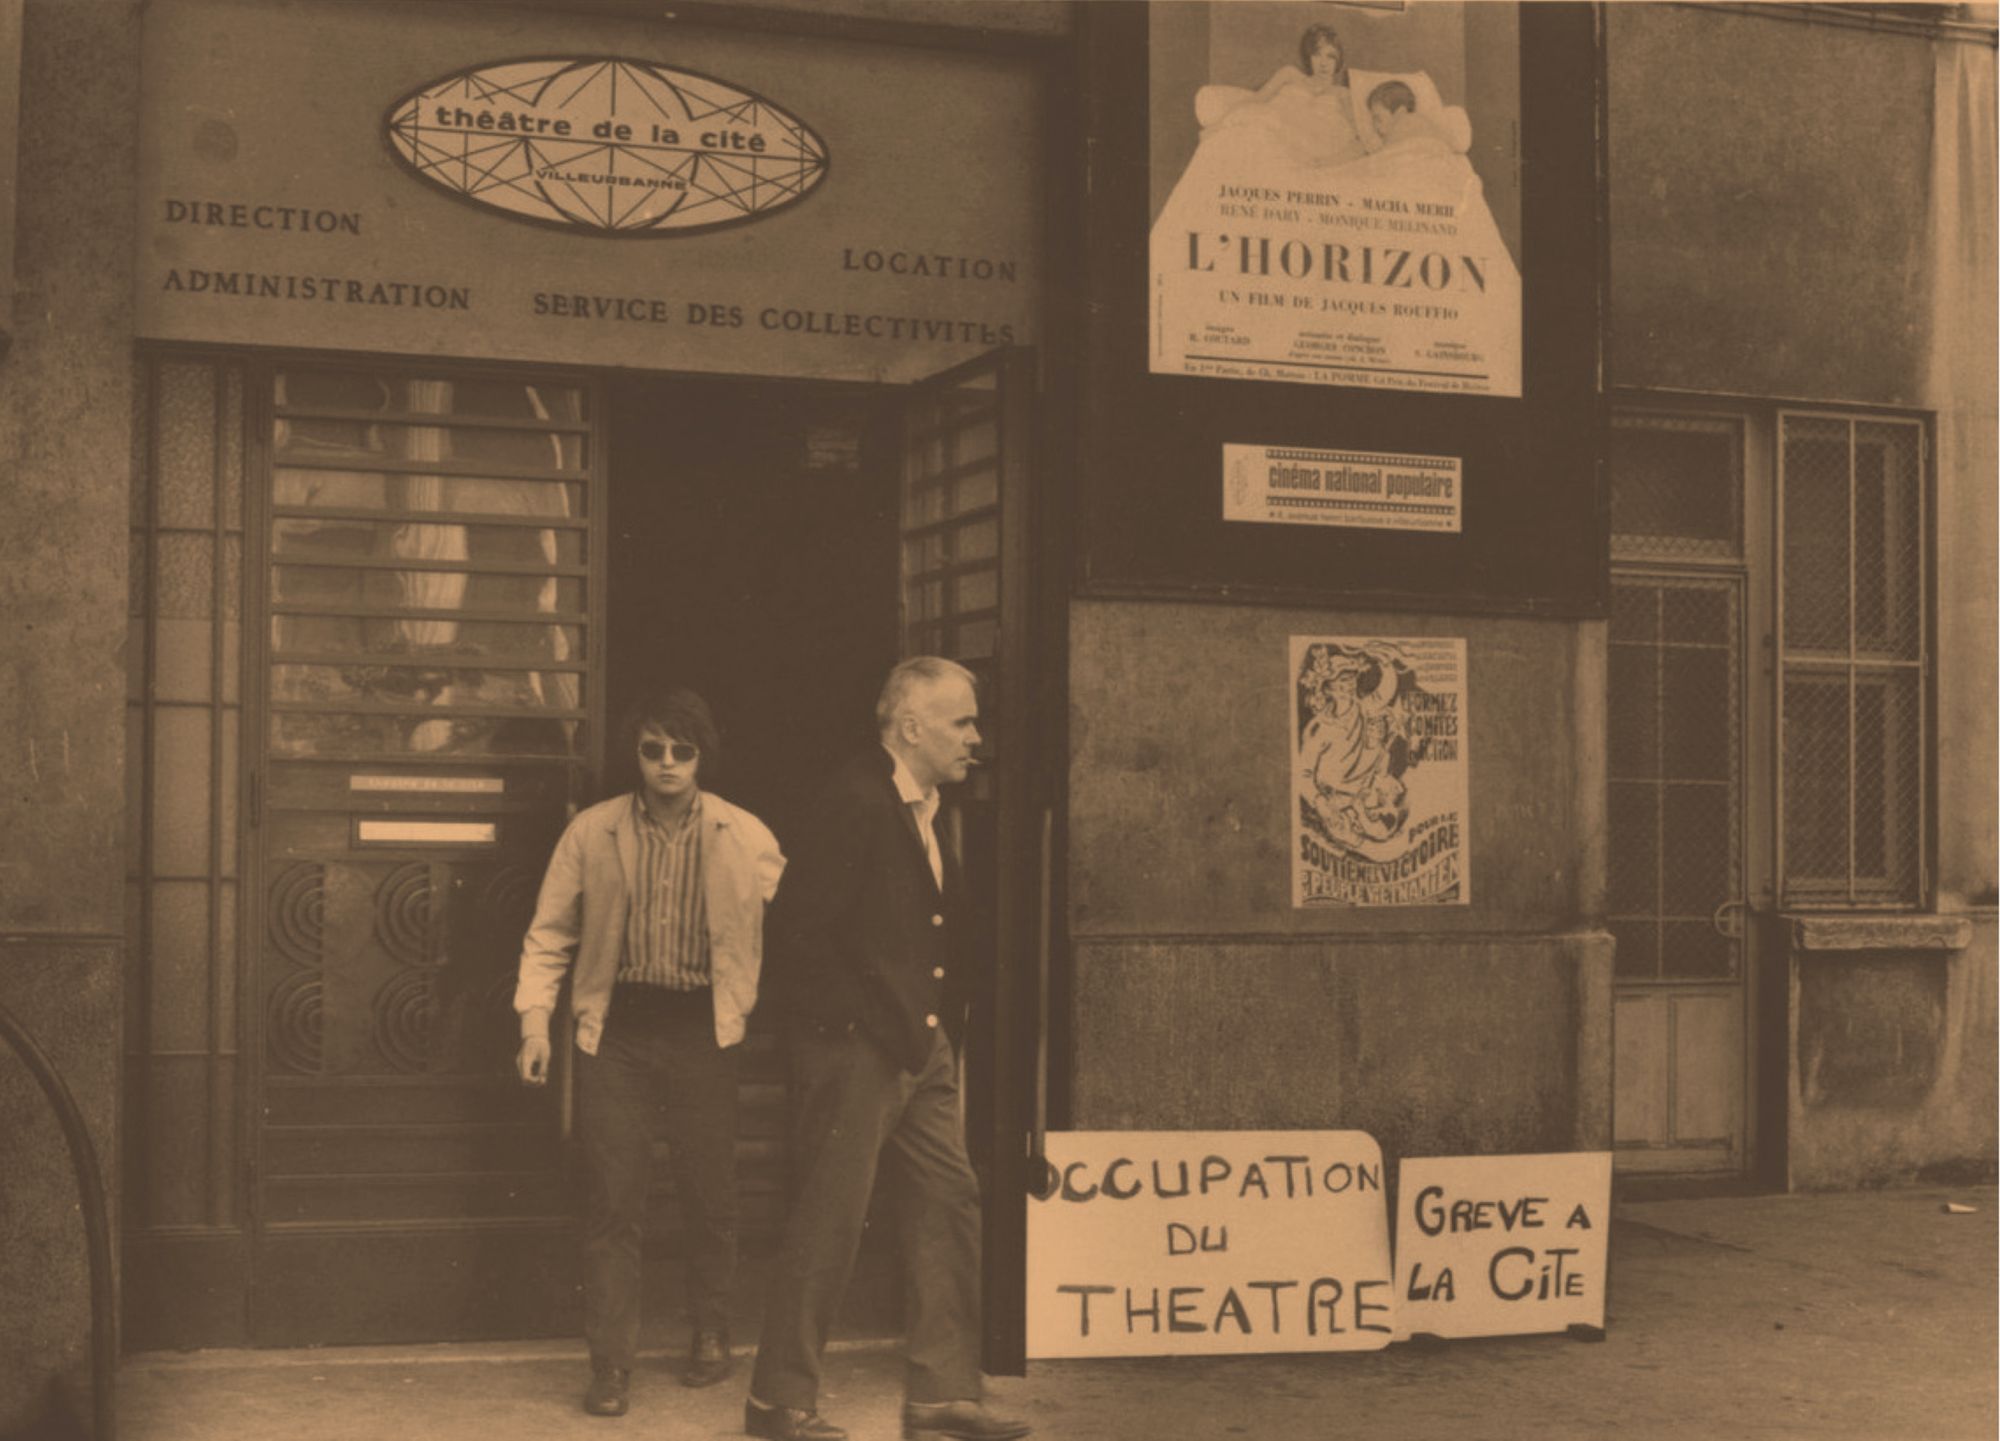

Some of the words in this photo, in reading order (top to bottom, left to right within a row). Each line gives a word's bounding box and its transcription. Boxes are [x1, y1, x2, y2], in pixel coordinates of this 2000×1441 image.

[436, 105, 571, 137] théâtre
[593, 113, 632, 141] de
[652, 123, 679, 146] la
[699, 128, 767, 153] cité
[535, 170, 687, 191] VILLEURBANNE
[1219, 184, 1281, 202] JACQUES
[1287, 190, 1339, 207] PERRIN
[1362, 197, 1408, 214] MACHA
[166, 200, 361, 235] DIRECTION
[843, 248, 1018, 284] LOCATION
[1187, 232, 1489, 294] L'HORIZON
[162, 268, 471, 310] ADMINISTRATION
[1219, 289, 1241, 304] UN
[1248, 292, 1281, 308] FILM
[1292, 295, 1313, 310] DE
[1321, 298, 1387, 316] JACQUES
[1392, 304, 1460, 321] ROUFFIO
[534, 292, 668, 323] SERVICE
[686, 302, 743, 330] DES
[1268, 461, 1320, 491] cinéma
[1325, 466, 1382, 495] national
[1386, 471, 1453, 501] populaire
[1414, 1185, 1550, 1237] GREVE
[1566, 1203, 1592, 1229] A
[1167, 1223, 1228, 1255] DU
[1407, 1262, 1455, 1302] LA
[1056, 1277, 1393, 1337] THEATRE
